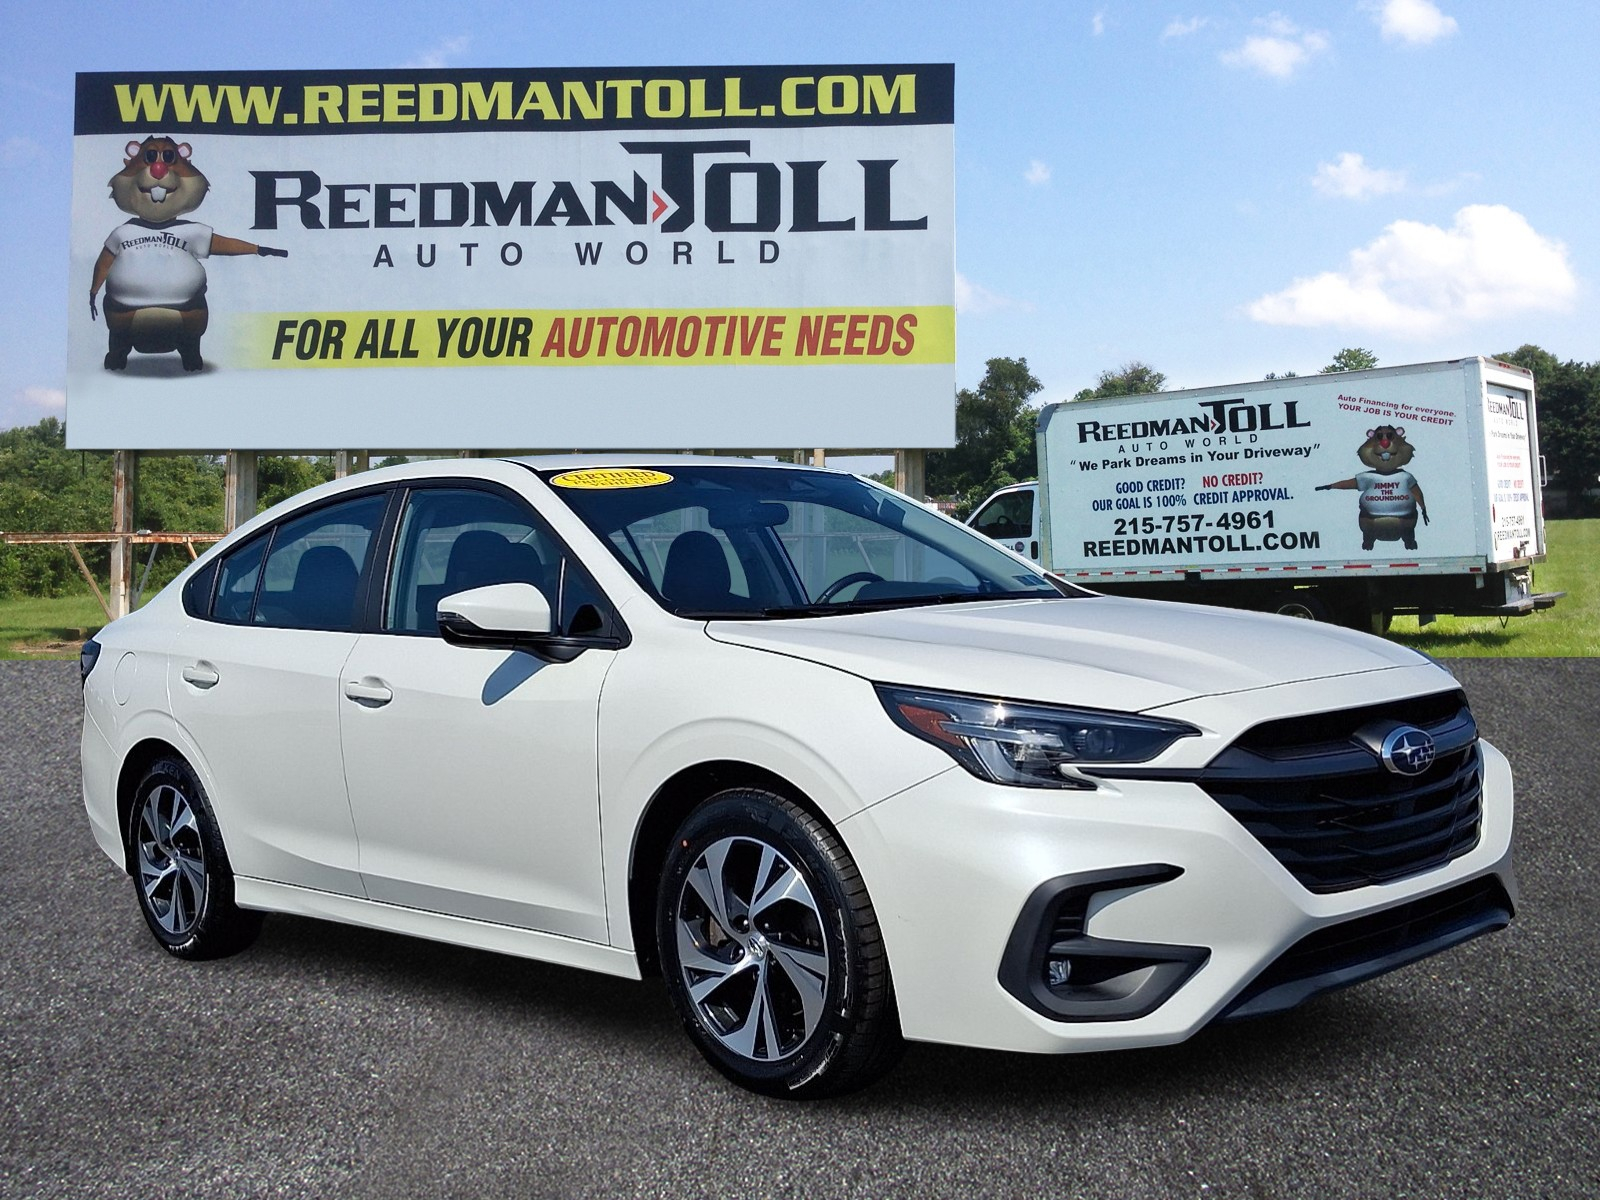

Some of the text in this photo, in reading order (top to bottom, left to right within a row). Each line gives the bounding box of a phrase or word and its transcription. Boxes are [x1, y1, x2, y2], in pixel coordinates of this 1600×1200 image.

[114, 73, 917, 125] WWW.REEDMANTOLL.COM
[373, 240, 780, 269] AUTO WORLD
[272, 313, 918, 360] FOR ALL YOUR AUTOMOTIVE NEEDS
[1338, 394, 1457, 417] Auto Financing for everyone.
[1338, 403, 1361, 412] YOUR
[1364, 407, 1380, 415] JOB
[1394, 411, 1418, 421] YOUR
[1420, 415, 1454, 426] CREDIT
[1118, 434, 1258, 453] AUTO WORLD
[1102, 458, 1132, 469] Park
[1136, 455, 1186, 467] Dreams
[1190, 452, 1203, 463] in
[1208, 451, 1240, 462] Your
[562, 471, 655, 482] CERTIFIED
[1116, 478, 1186, 494] GOOD CREDIT?
[1202, 472, 1263, 488] NO CREDIT?
[1374, 482, 1400, 490] JIMMY
[1092, 487, 1294, 512] OUR GOAL IS 100% CREDIT APPROVAL.
[1114, 510, 1274, 536] 215-757-4961
[1083, 531, 1320, 557] REEDMANTOLL.COM
